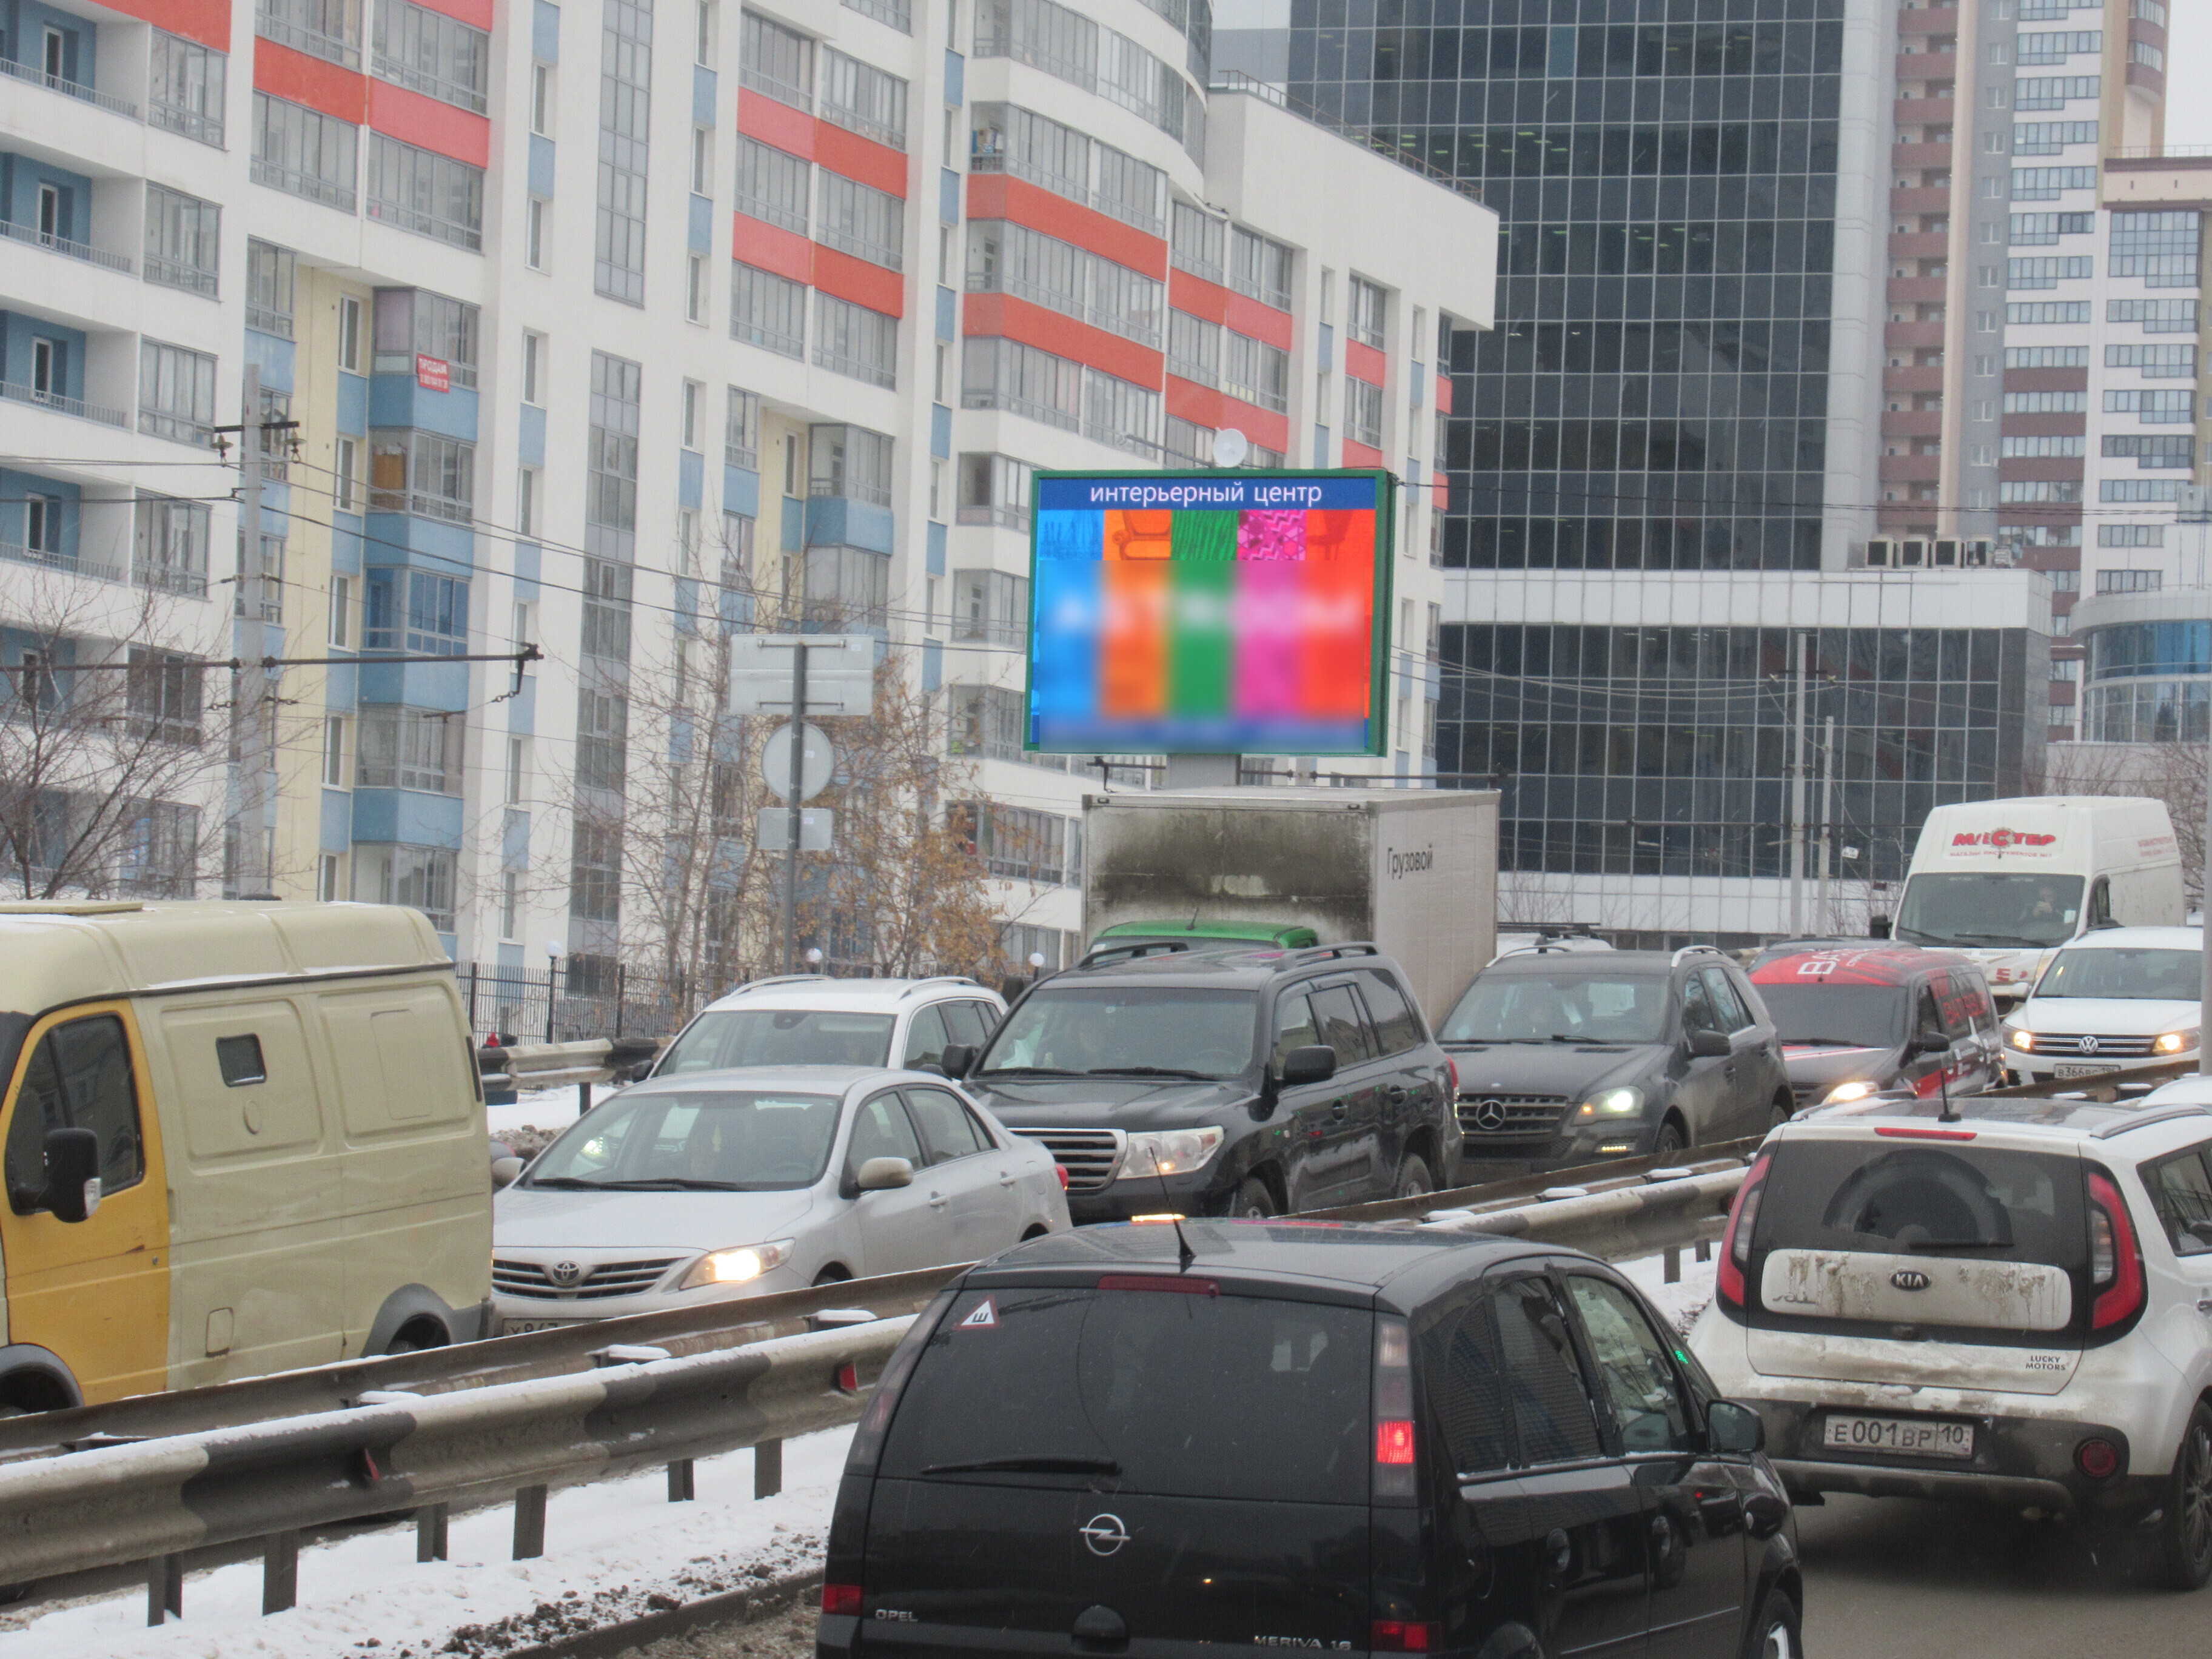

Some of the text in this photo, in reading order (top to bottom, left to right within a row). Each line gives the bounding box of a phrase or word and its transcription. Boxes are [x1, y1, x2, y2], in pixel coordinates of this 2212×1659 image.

[1090, 481, 1322, 508] интерьерный центр
[1386, 843, 1433, 880] Грузовой
[1895, 1273, 1925, 1287] KIA
[971, 1312, 990, 1323] Ш
[2025, 1362, 2066, 1371] MOTORS
[875, 1609, 919, 1623] OPEL
[1254, 1635, 1322, 1649] MERIVA
